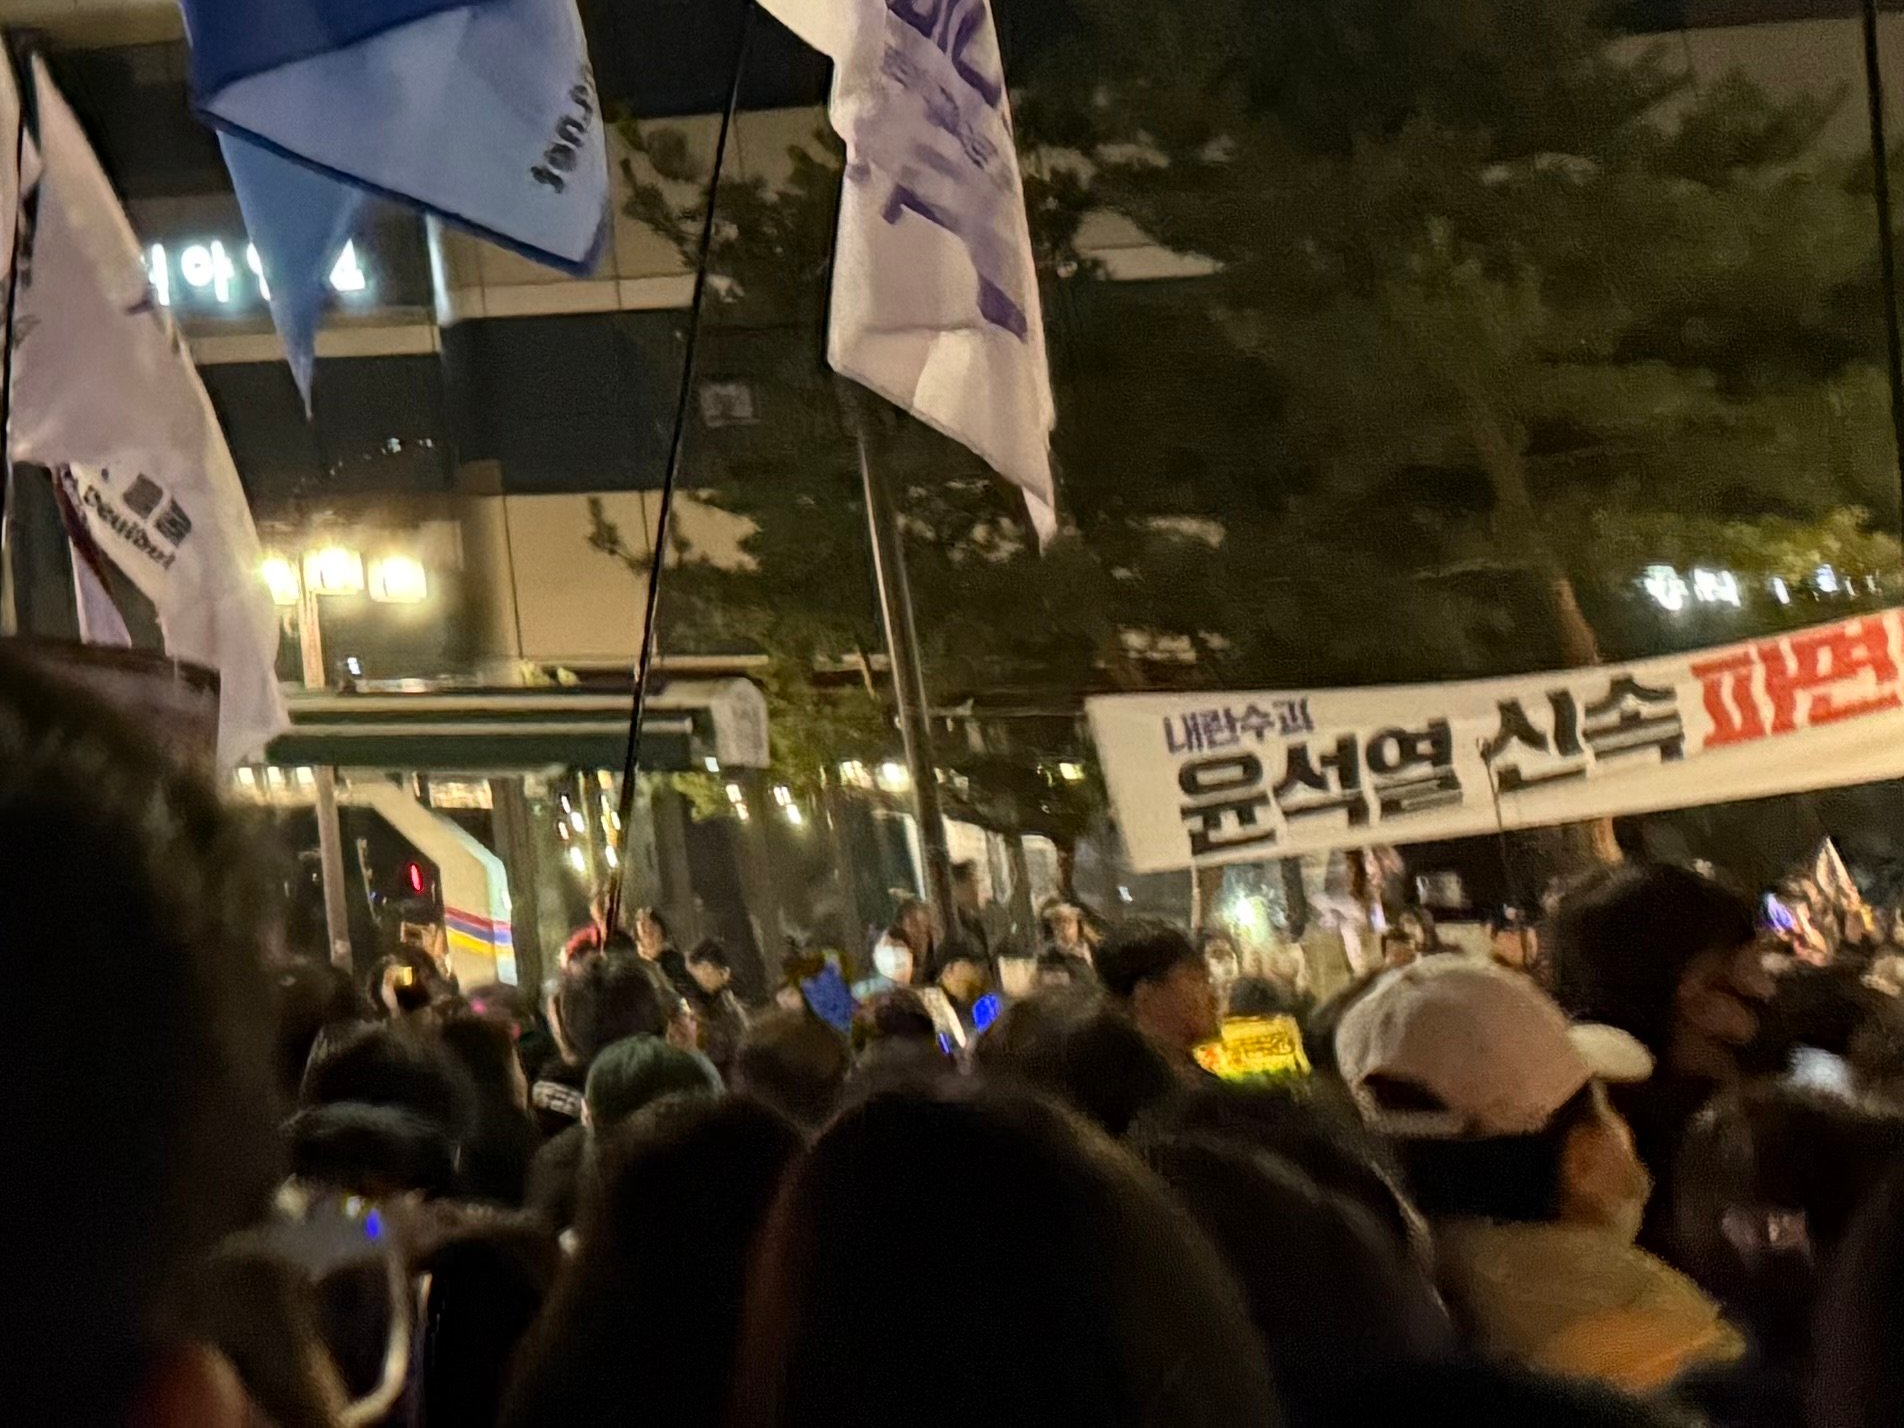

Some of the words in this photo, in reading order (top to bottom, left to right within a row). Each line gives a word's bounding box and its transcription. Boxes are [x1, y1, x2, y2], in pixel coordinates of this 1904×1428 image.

[1163, 697, 1315, 754] 내란수괴
[1178, 716, 1464, 856] 윤석열
[1486, 673, 1687, 794] 신속
